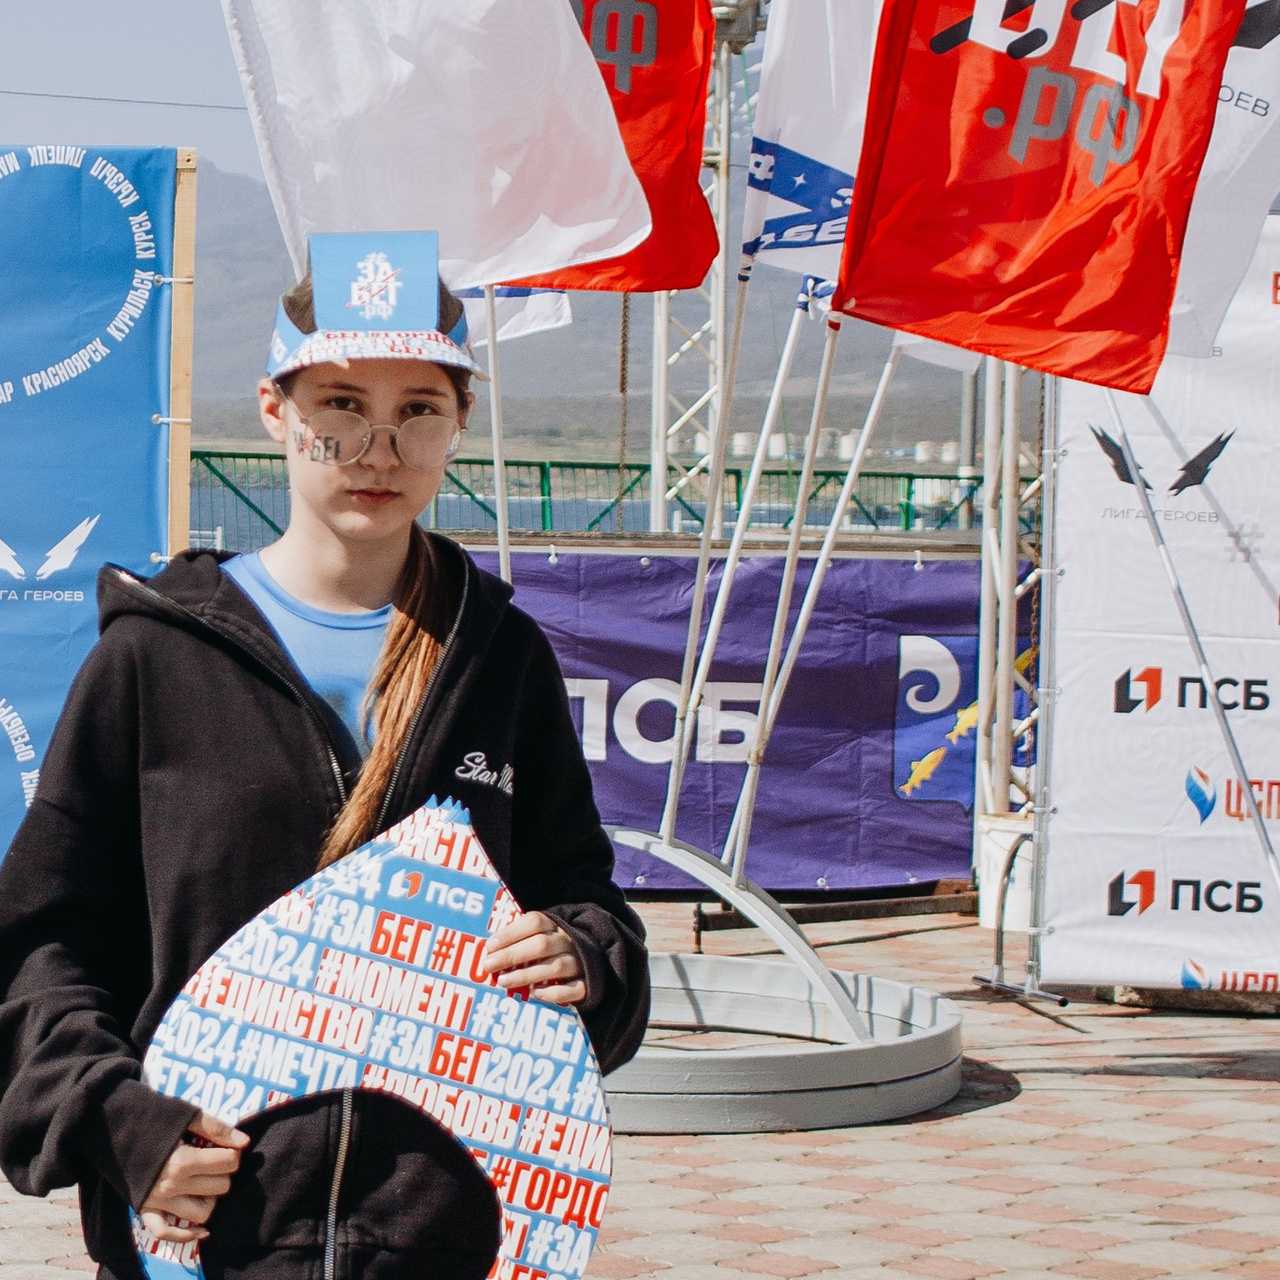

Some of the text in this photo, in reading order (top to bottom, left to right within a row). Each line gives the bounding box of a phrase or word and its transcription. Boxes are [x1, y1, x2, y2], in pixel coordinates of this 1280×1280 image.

[1218, 84, 1271, 118] ОЕВ
[27, 145, 87, 169] ЛИПЕЦК
[89, 156, 141, 208] КЫЗЫЛ
[128, 210, 156, 260] КУРСК
[106, 268, 155, 342] КУРИЛЬСК
[22, 337, 111, 397] КРАСНОЯРСК
[1101, 507, 1149, 519] ЛИГА
[23, 590, 85, 602] ГЕРОЕВ
[1176, 675, 1271, 711] ПСБ
[454, 751, 499, 785] Star
[425, 879, 485, 916] ПСБ
[1170, 878, 1264, 914] ПСБ
[312, 893, 433, 965] #ЗАБЕГ
[314, 946, 475, 1032] #МОМЕНТ
[527, 1219, 593, 1278] #ЗА
